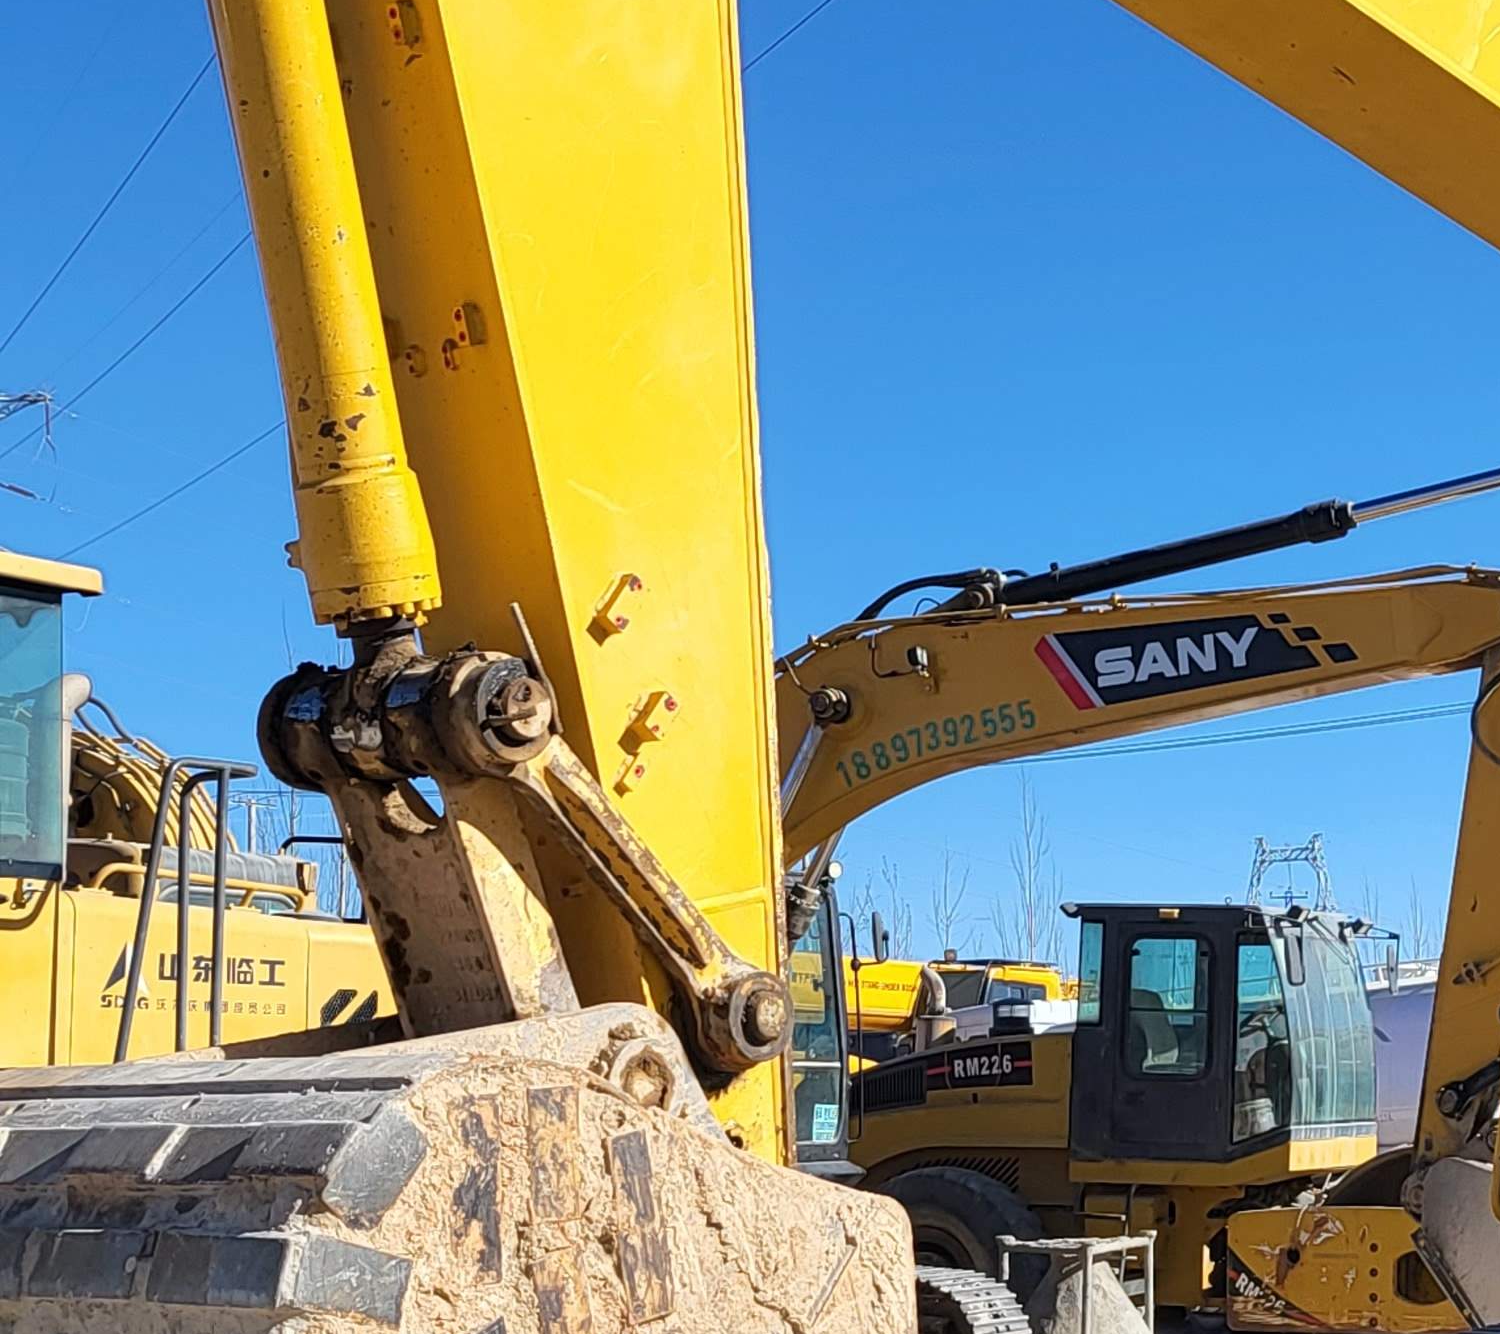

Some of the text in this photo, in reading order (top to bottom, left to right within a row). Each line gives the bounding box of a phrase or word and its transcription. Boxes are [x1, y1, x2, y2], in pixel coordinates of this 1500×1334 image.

[1094, 626, 1259, 688] SANY
[836, 699, 1036, 788] 18897392555
[158, 953, 286, 987] 山东临工
[100, 994, 149, 1009] SDG
[953, 1054, 1012, 1078] RM226
